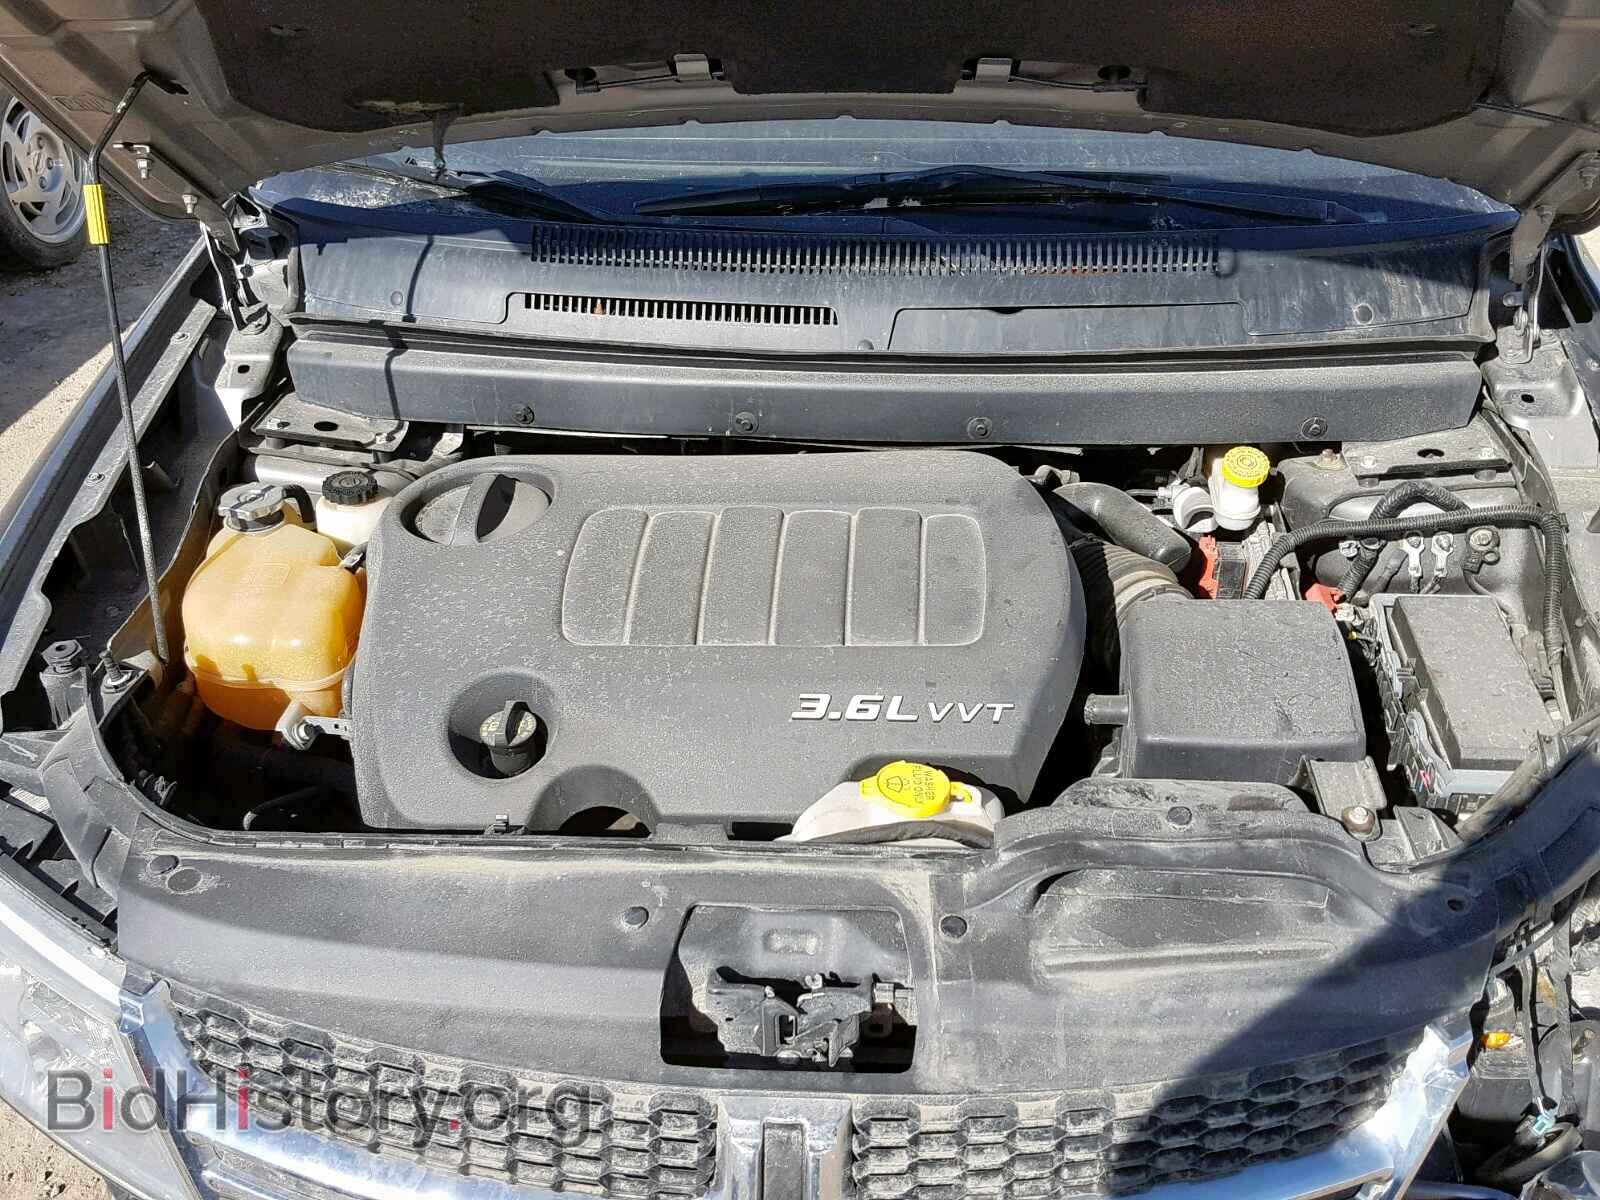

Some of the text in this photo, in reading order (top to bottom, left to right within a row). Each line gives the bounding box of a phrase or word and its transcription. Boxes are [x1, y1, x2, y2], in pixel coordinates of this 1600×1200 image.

[791, 693, 1015, 724] 3.6L VVT
[912, 765, 922, 784] FLUID
[923, 771, 936, 800] WASHER
